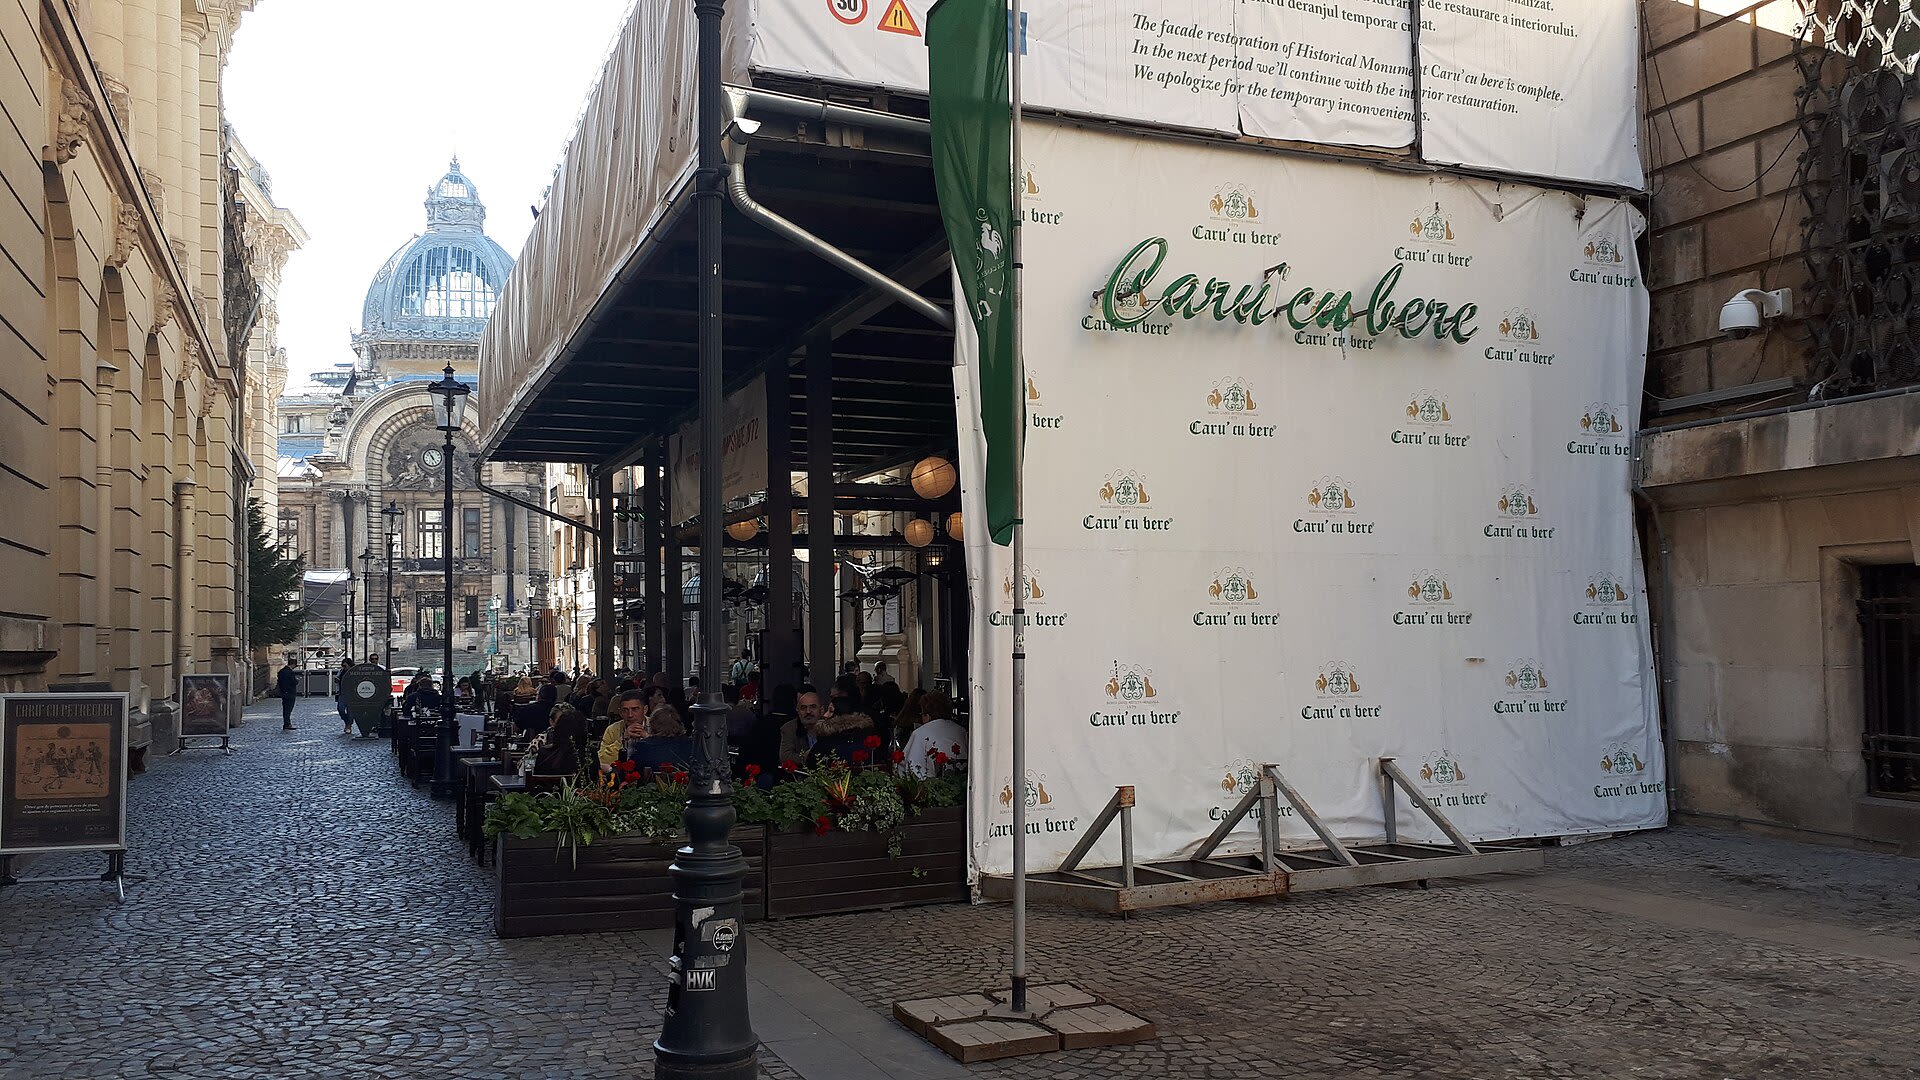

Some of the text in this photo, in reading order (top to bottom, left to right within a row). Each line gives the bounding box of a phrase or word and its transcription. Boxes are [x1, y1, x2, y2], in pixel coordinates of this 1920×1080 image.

[1288, 0, 1338, 20] deranjul
[1342, 9, 1398, 30] temporar
[1444, 2, 1500, 22] restaurare
[1502, 14, 1508, 24] a
[1511, 13, 1578, 38] interiorului.
[1133, 13, 1157, 32] The
[1157, 19, 1204, 39] facade
[1207, 30, 1279, 52] restoration
[1282, 42, 1296, 59] of
[1296, 43, 1358, 67] Historical
[1465, 74, 1478, 85] cu
[1480, 73, 1504, 89] bere
[1507, 78, 1515, 91] is
[1517, 83, 1564, 102] complete.
[1132, 39, 1148, 55] In
[1152, 43, 1173, 59] the
[1177, 51, 1207, 63] next
[1208, 54, 1254, 71] period
[1289, 70, 1341, 87] continue
[1344, 78, 1373, 93] with
[1376, 82, 1395, 96] the
[1446, 92, 1518, 113] restauration.
[1134, 64, 1154, 80] We
[1157, 71, 1221, 93] apologize
[1220, 78, 1244, 97] for
[1248, 82, 1268, 98] the
[1271, 89, 1335, 113] temporary
[1192, 225, 1230, 242] Caru'
[1232, 231, 1246, 243] cu
[1394, 246, 1430, 262] Caru'
[1432, 253, 1444, 264] cu
[1602, 274, 1613, 285] cu
[1286, 286, 1354, 333] cu
[1366, 262, 1483, 344] bere
[1295, 331, 1330, 346] Caru'
[1485, 346, 1517, 361] Caru'
[1519, 352, 1530, 362] cu
[1190, 420, 1230, 435] Caru'
[1232, 425, 1244, 436] cu
[1391, 430, 1426, 445] Caru'
[1428, 435, 1440, 445] cu
[1600, 445, 1611, 456] cu
[1083, 514, 1122, 530] Caru'
[1124, 519, 1138, 530] cu
[1294, 518, 1328, 533] Caru'
[1331, 523, 1343, 533] cu
[1484, 523, 1515, 538] Caru'
[1517, 527, 1528, 538] cu
[1193, 611, 1231, 626] Caru'
[1233, 614, 1246, 626] cu
[1393, 612, 1428, 625] Caru'
[1430, 615, 1443, 625] cu
[1606, 615, 1617, 625] cu
[1302, 705, 1336, 720] Caru'
[1340, 708, 1352, 718] cu
[1494, 700, 1526, 714] Caru'
[1528, 703, 1540, 713] cu
[1090, 711, 1129, 727] Caru'
[1131, 714, 1146, 725] cu
[1625, 785, 1637, 795] cu
[1446, 796, 1459, 807] cu
[1025, 822, 1040, 834] cu
[688, 971, 714, 988] HVK
